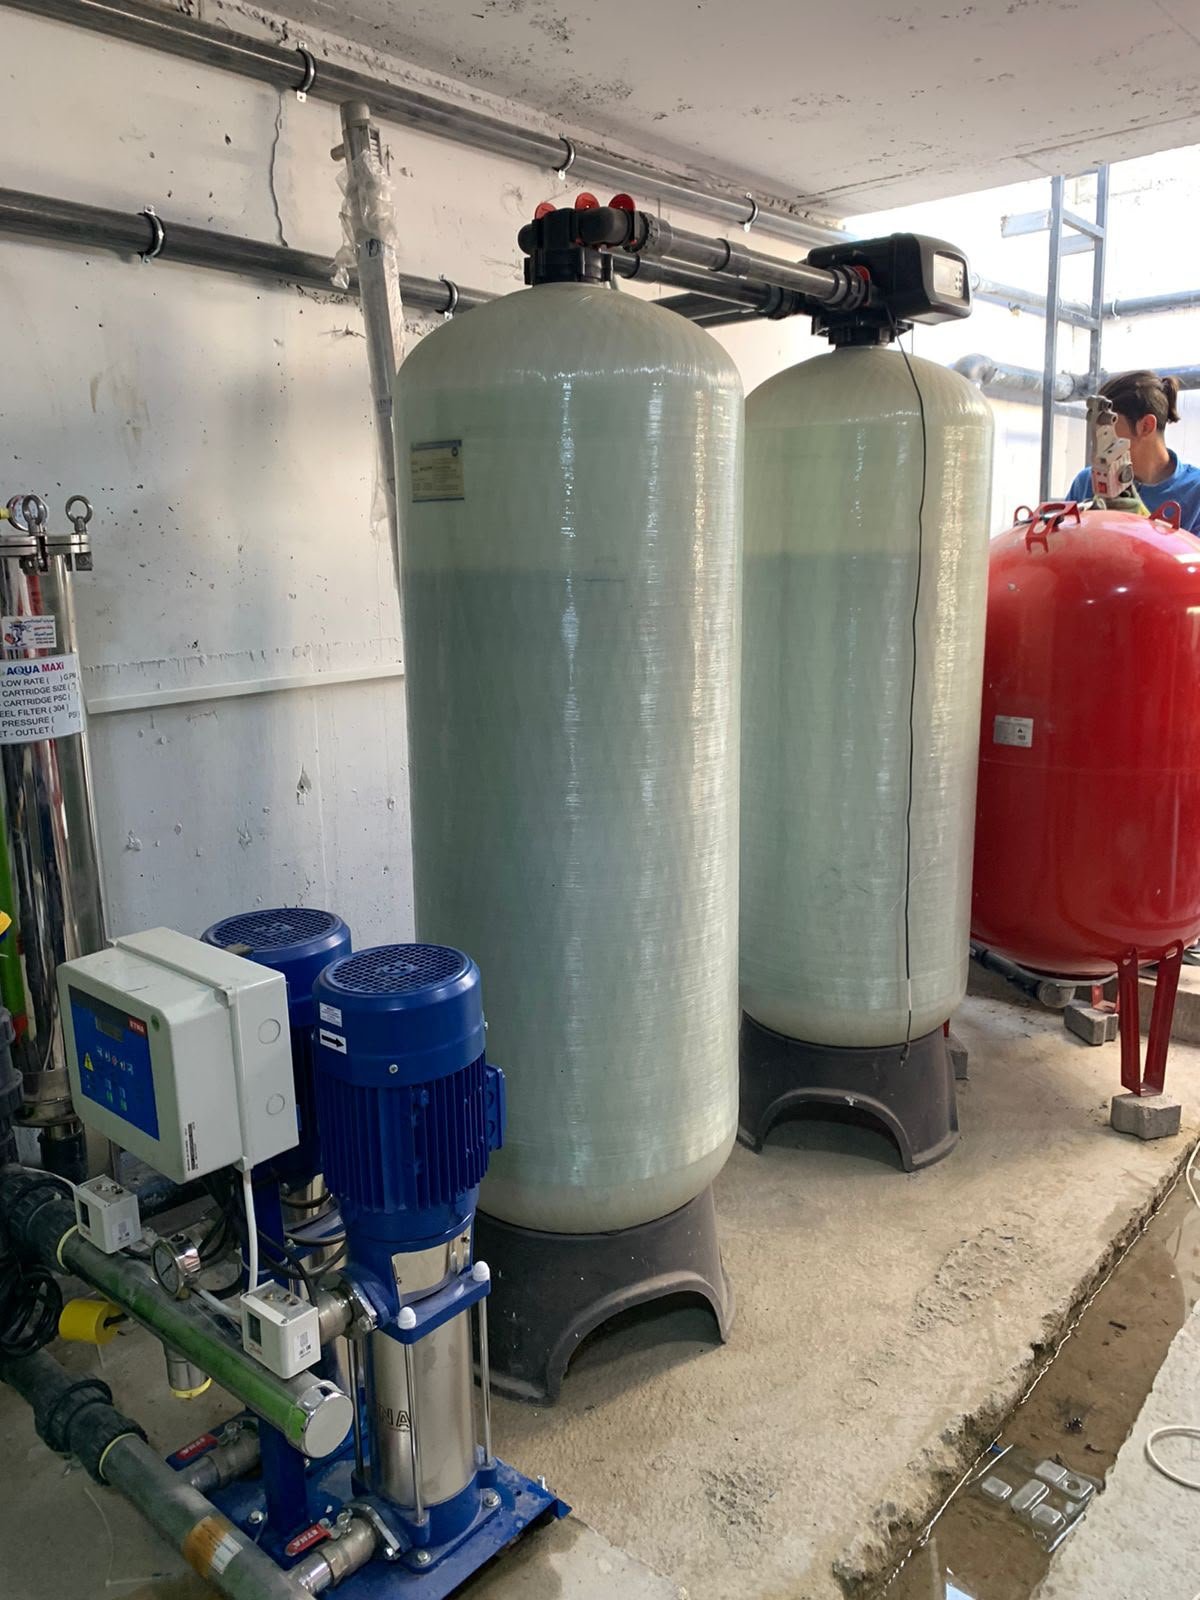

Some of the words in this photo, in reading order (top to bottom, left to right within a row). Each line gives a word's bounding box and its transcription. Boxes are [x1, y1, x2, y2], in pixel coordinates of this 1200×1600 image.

[7, 665, 40, 676] AQUA
[23, 677, 45, 685] RATE
[2, 686, 51, 697] CARTRIDGE
[52, 684, 66, 693] SIZE
[3, 696, 52, 707] CARTRIDGE
[18, 707, 47, 717] FILTER
[2, 716, 49, 727] PRESSURE
[15, 726, 49, 737] OUTLET
